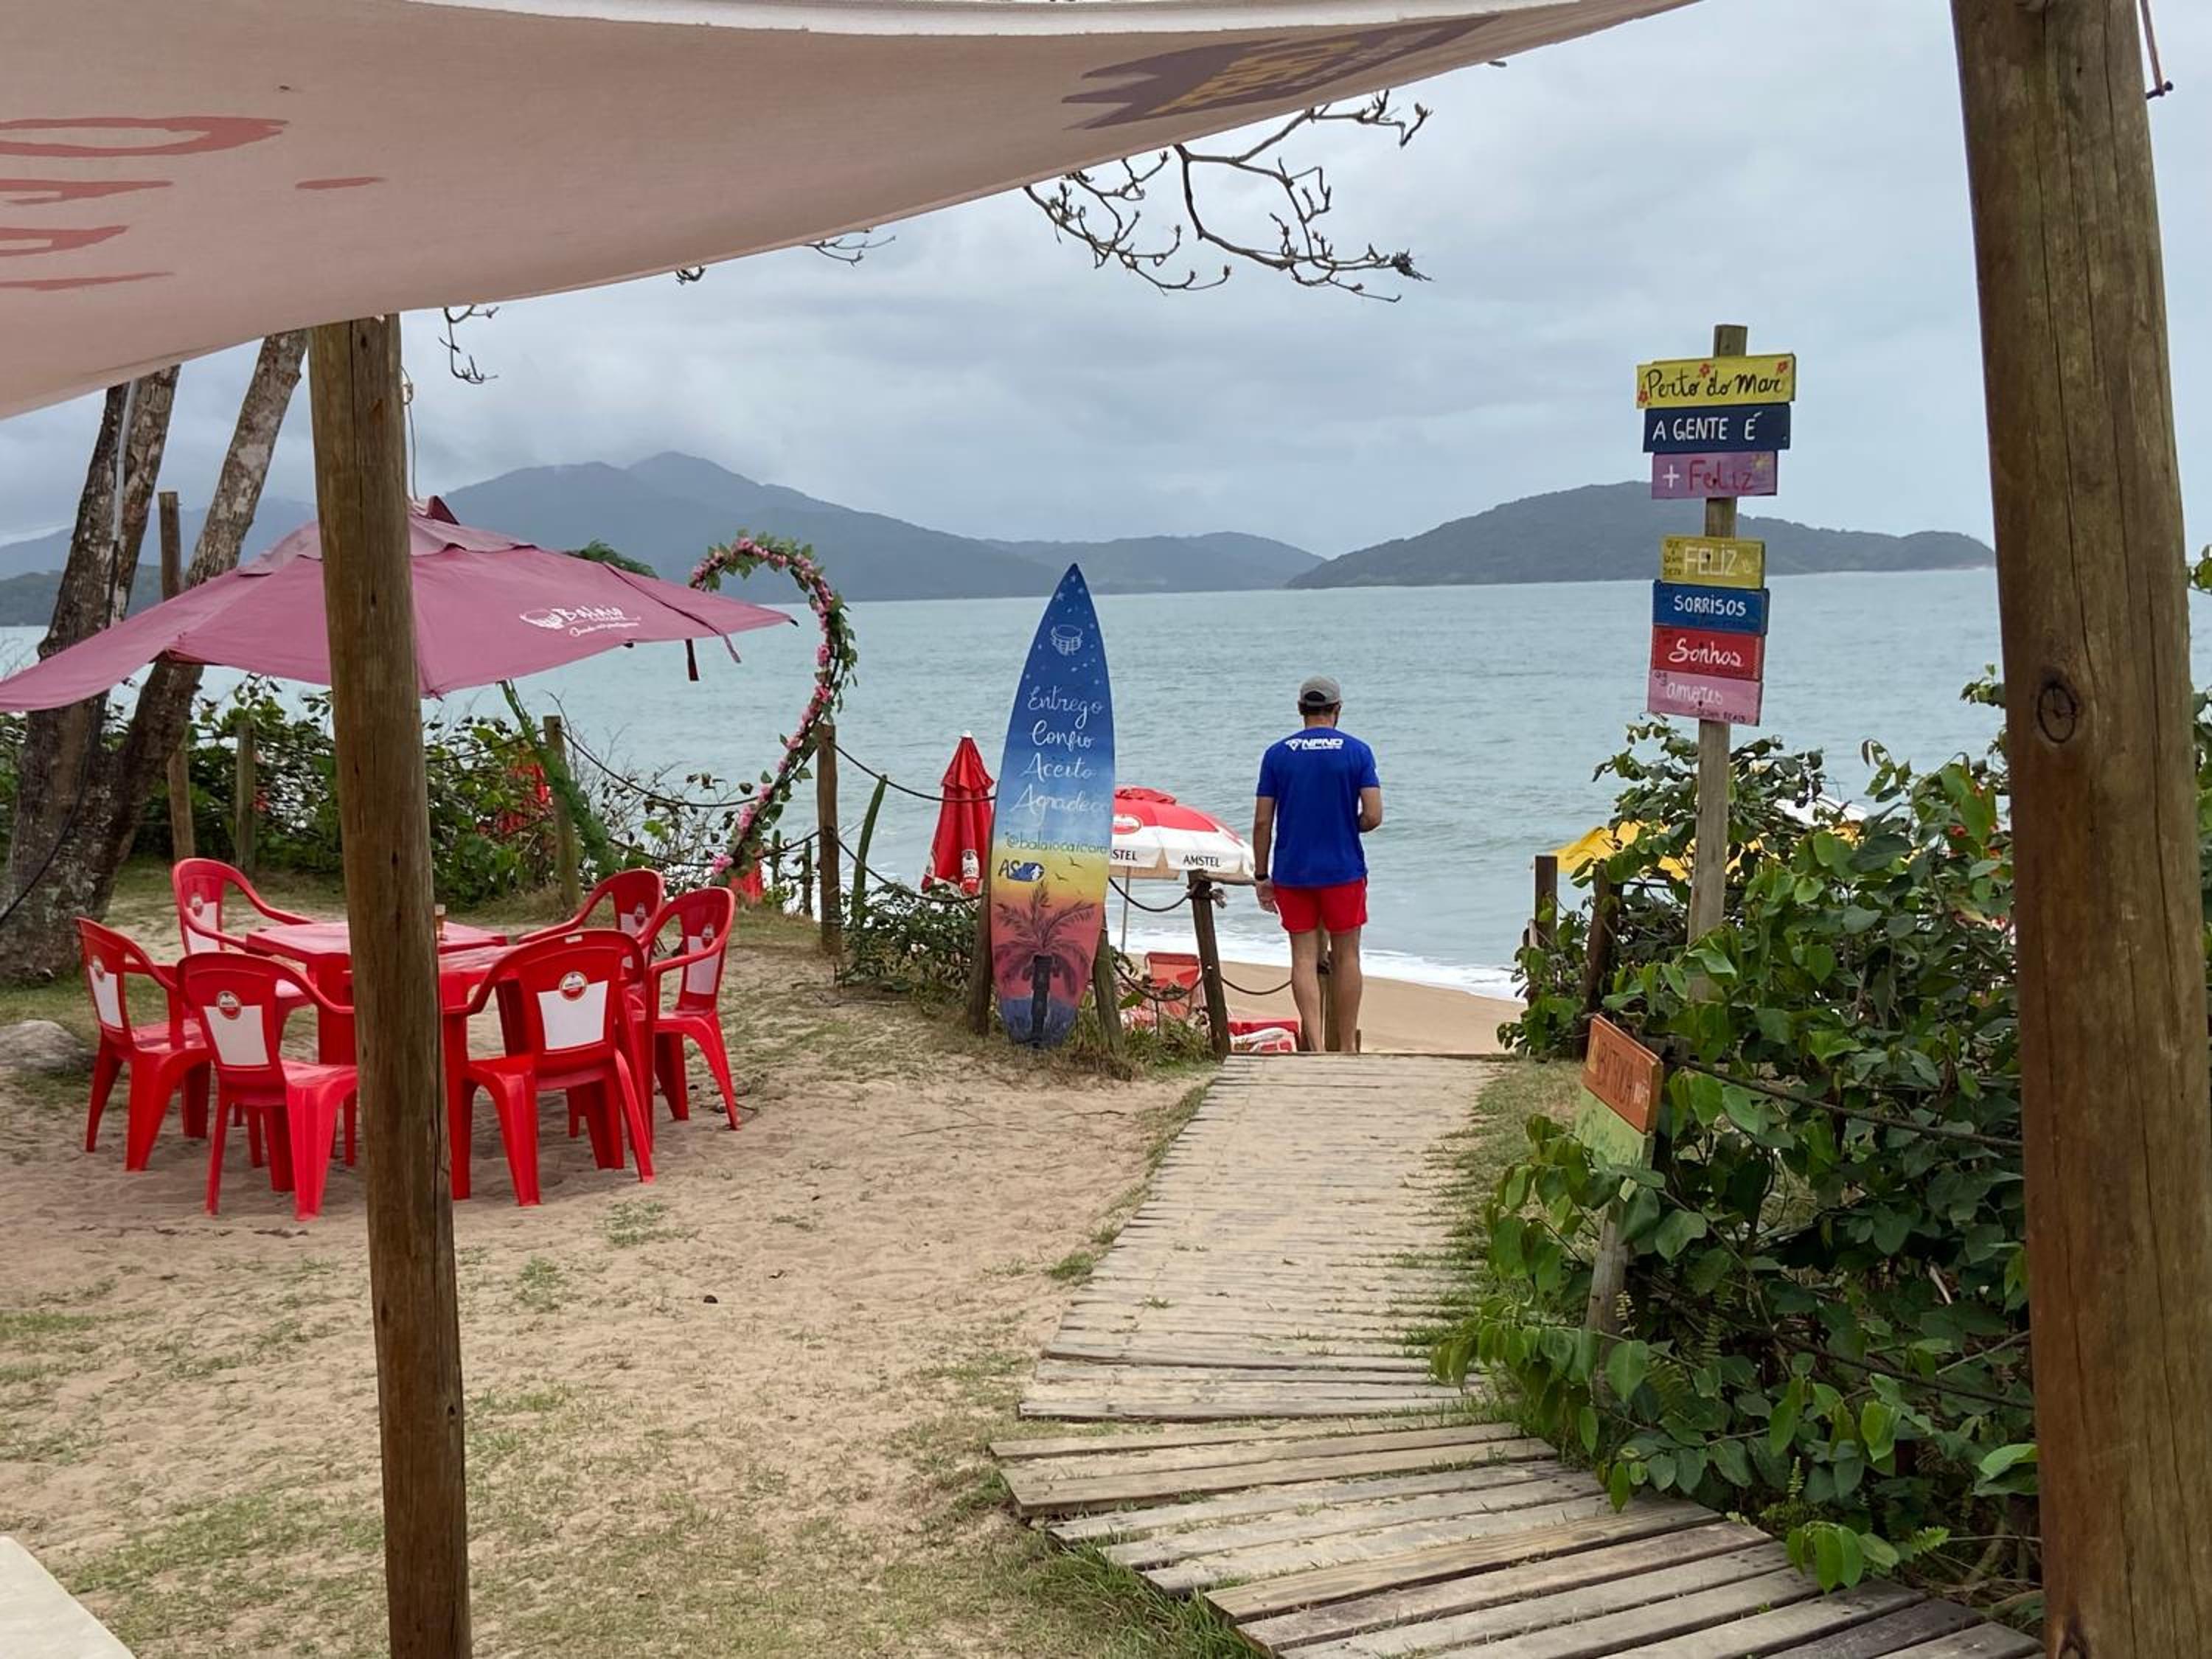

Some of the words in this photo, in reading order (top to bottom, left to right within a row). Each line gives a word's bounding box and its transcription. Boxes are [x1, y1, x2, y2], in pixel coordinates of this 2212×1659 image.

[1646, 369, 1701, 397] Perto
[1706, 370, 1732, 397] do
[1734, 373, 1782, 394] Mar
[1652, 420, 1666, 441] A
[1673, 417, 1729, 441] GENTE
[1744, 411, 1763, 441] É
[1688, 460, 1754, 492] Feliz
[1684, 544, 1737, 576] FELIZ
[1673, 594, 1747, 617] SORRISOS
[1668, 638, 1745, 667] Sonhos
[1027, 685, 1104, 728] Entrego
[1030, 719, 1095, 752] Confio
[1020, 751, 1097, 782] Aceito
[1113, 849, 1137, 861] STEL
[1183, 855, 1221, 868] AMSTEL
